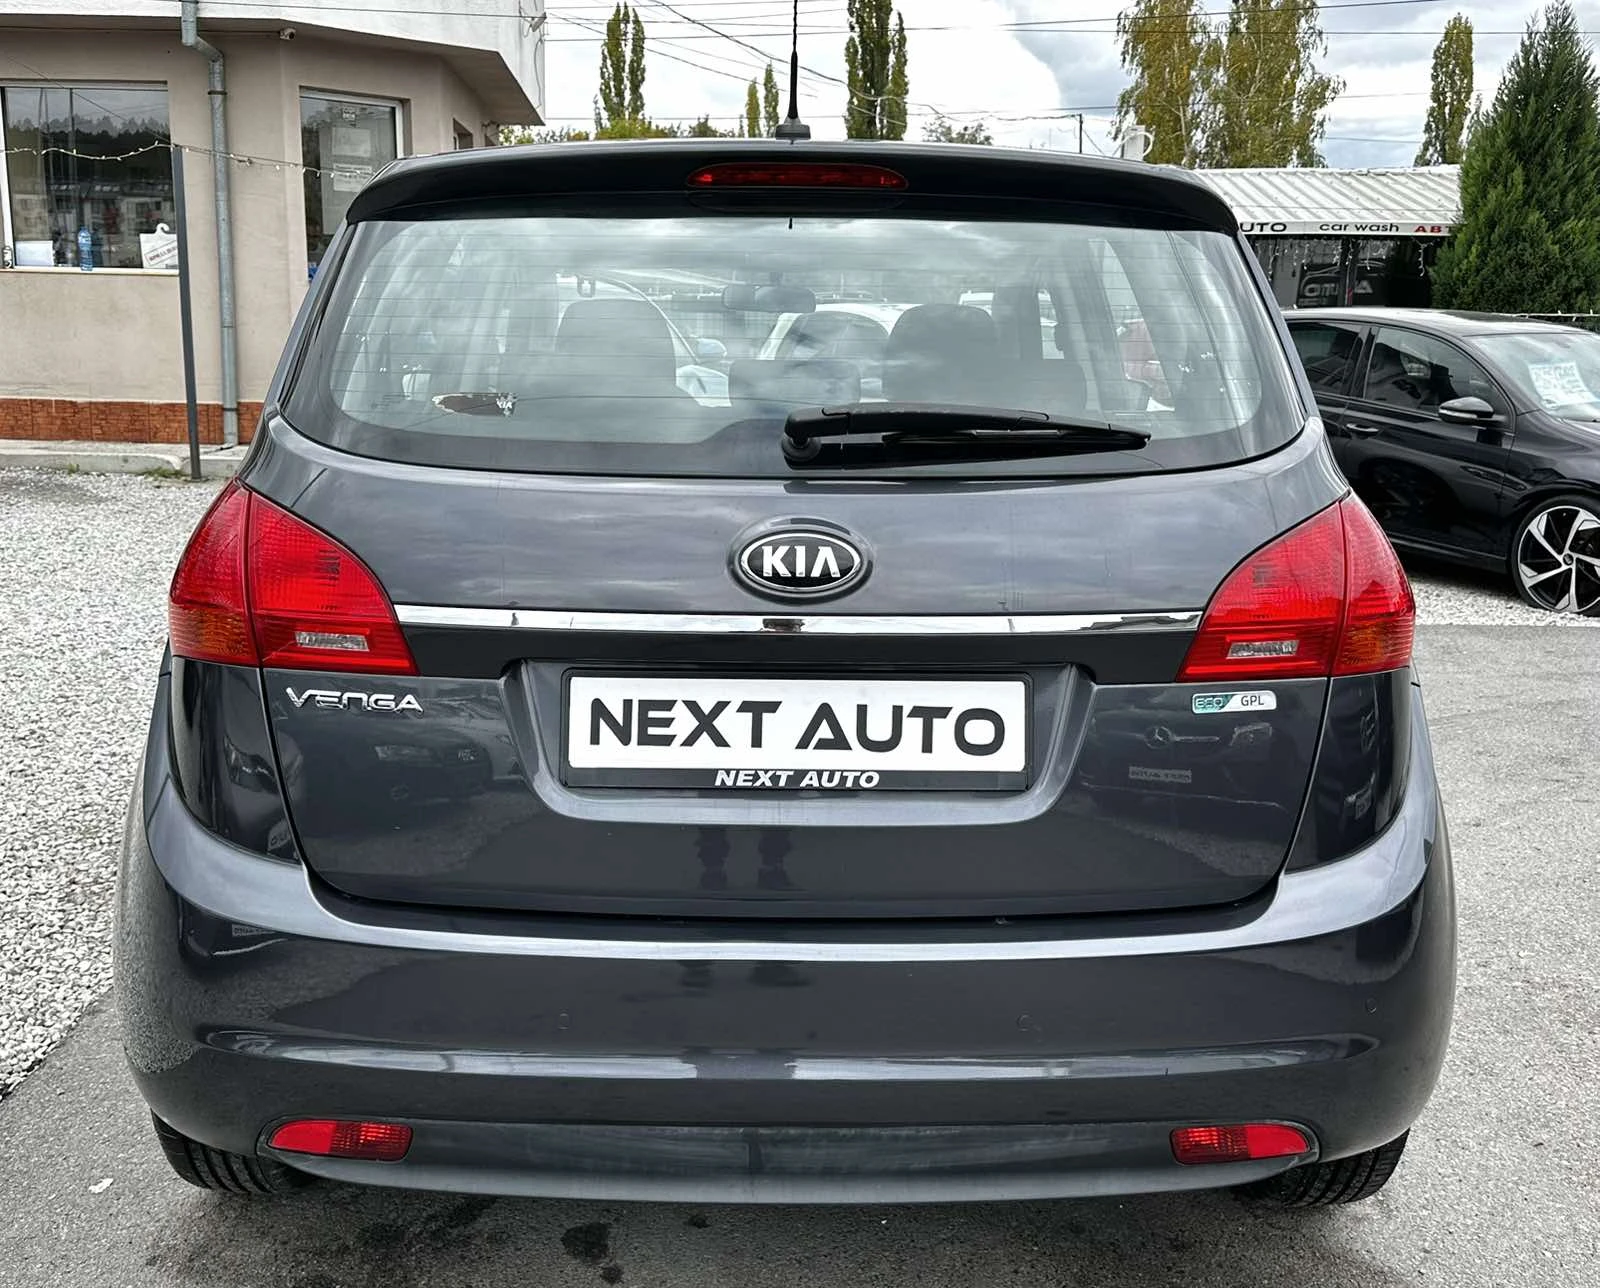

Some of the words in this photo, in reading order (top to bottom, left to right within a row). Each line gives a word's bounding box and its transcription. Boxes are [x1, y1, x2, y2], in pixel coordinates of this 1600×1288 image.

[1319, 223, 1349, 232] car
[1355, 223, 1400, 232] wash
[761, 545, 841, 578] KIA
[286, 687, 424, 713] VENGA
[1240, 695, 1265, 706] GPL
[589, 697, 783, 749] NEXT
[795, 702, 1006, 757] AUTO
[714, 770, 794, 788] NEXT
[799, 770, 880, 788] AUTO
